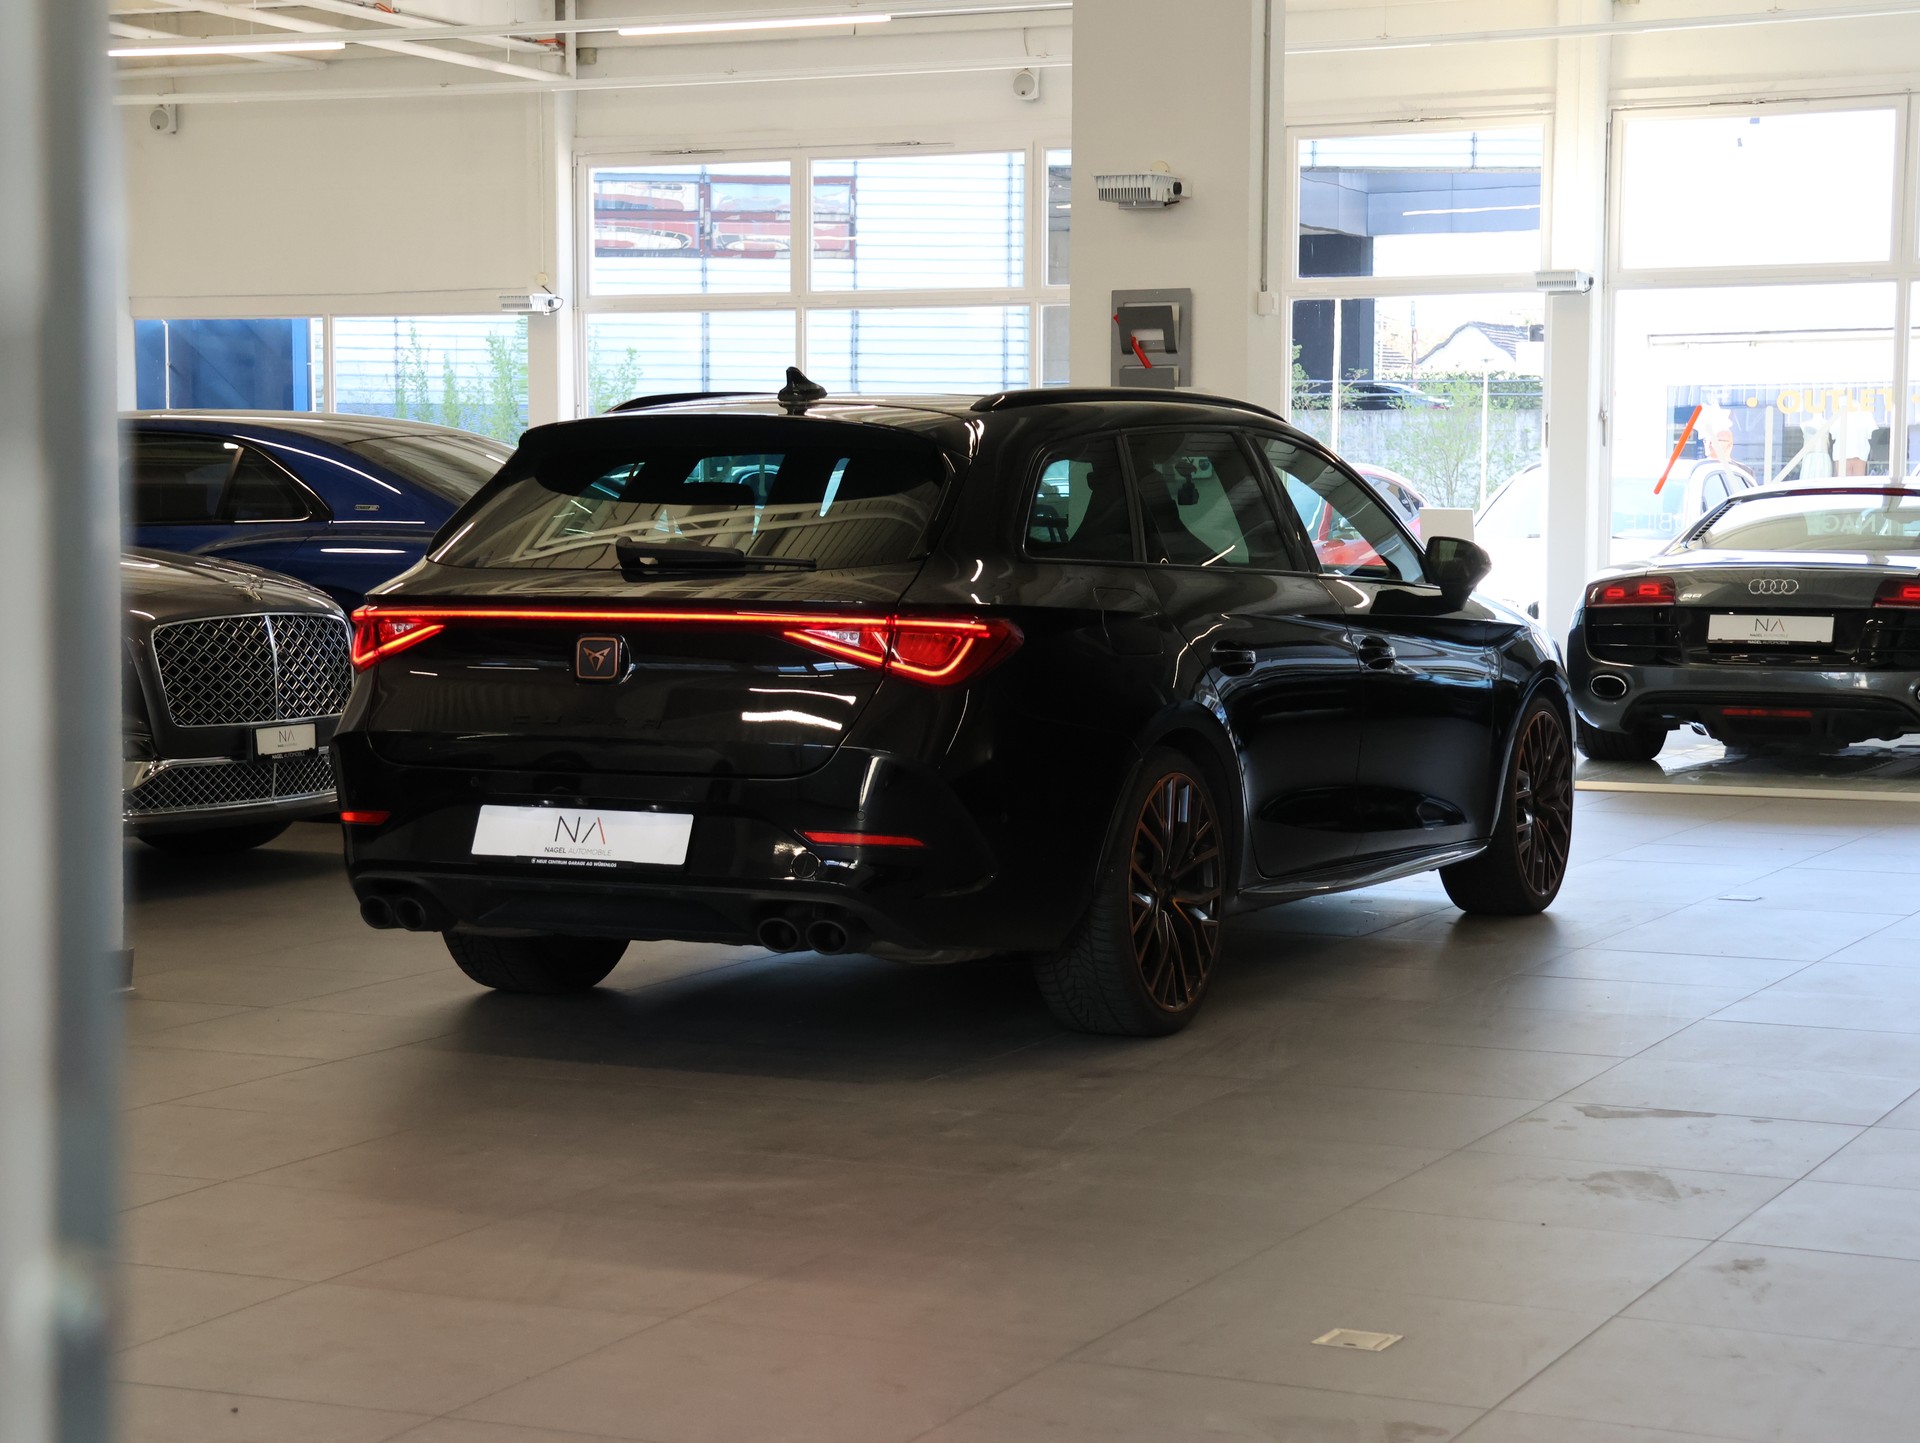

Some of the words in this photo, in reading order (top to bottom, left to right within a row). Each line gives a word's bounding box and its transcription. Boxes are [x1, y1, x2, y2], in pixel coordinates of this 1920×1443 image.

[1776, 387, 1893, 414] OUTLET
[554, 815, 606, 845] NA
[544, 846, 566, 854] NAGEL
[567, 847, 612, 857] AUTOMOBILE
